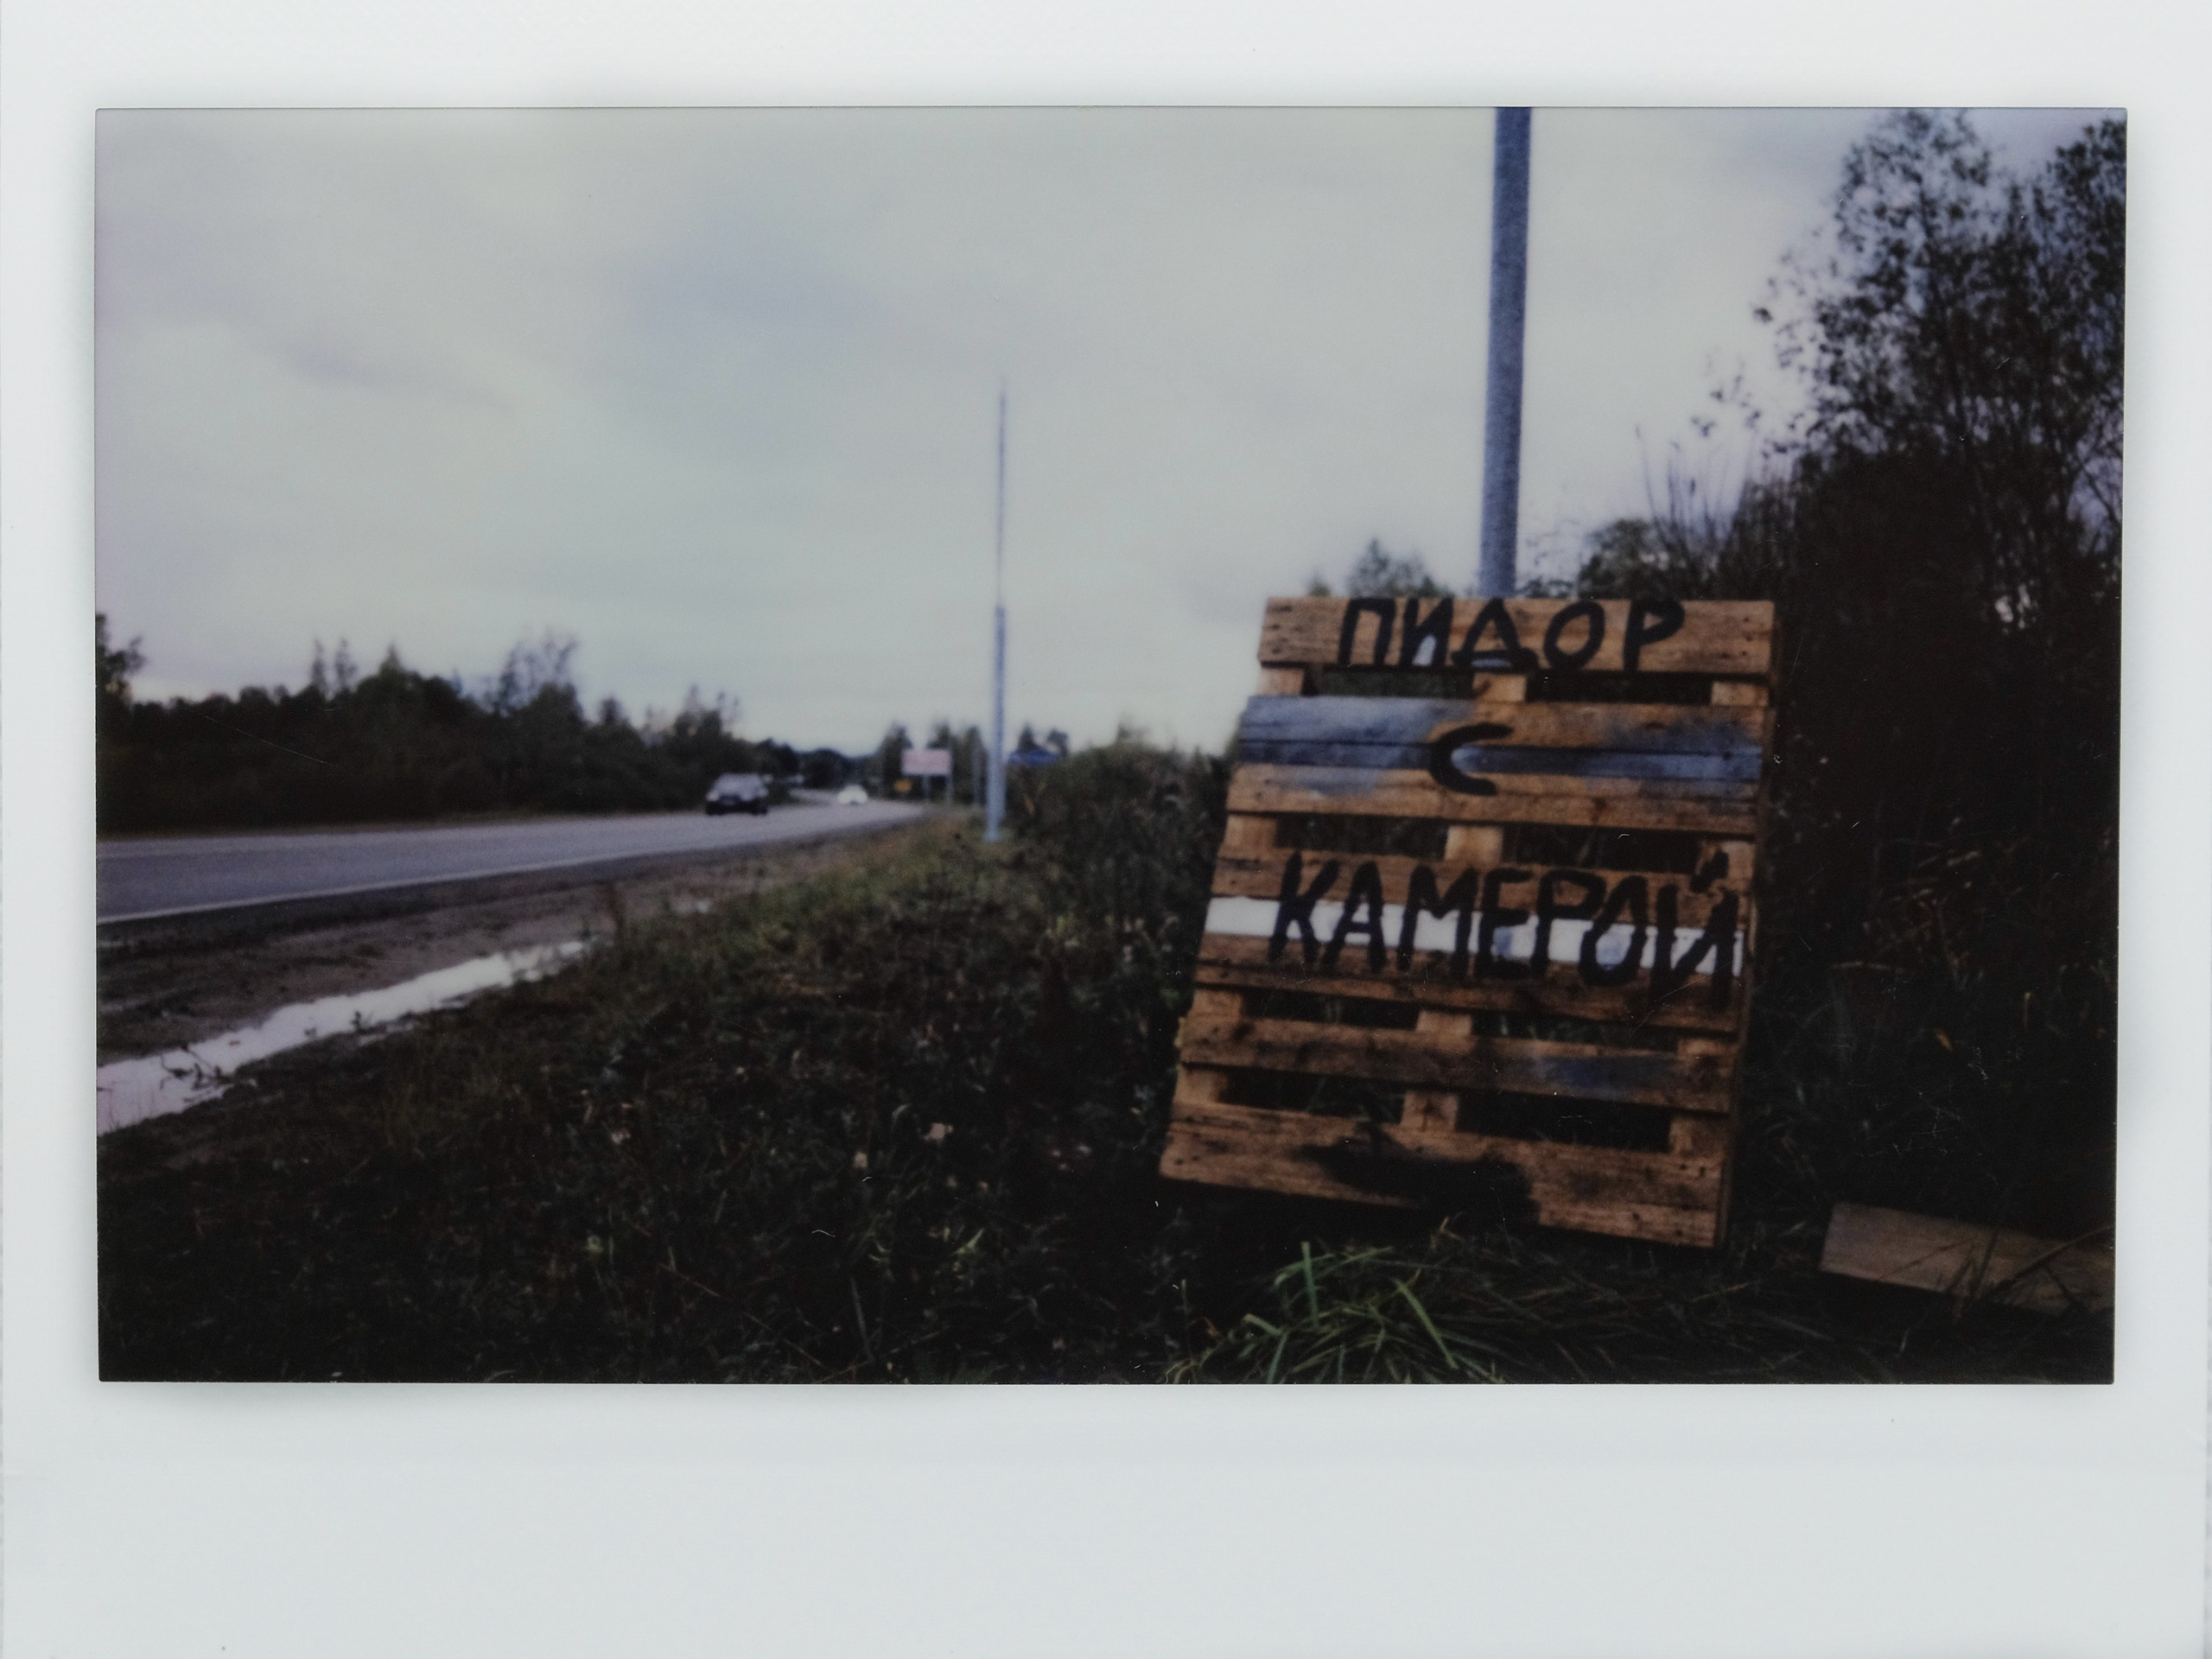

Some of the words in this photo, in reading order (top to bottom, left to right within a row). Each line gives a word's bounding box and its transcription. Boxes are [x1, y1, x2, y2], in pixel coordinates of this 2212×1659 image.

[1341, 597, 1686, 671] ПИДОР
[1428, 722, 1514, 796] С
[1268, 849, 1739, 1005] КАМЕРОЙ
